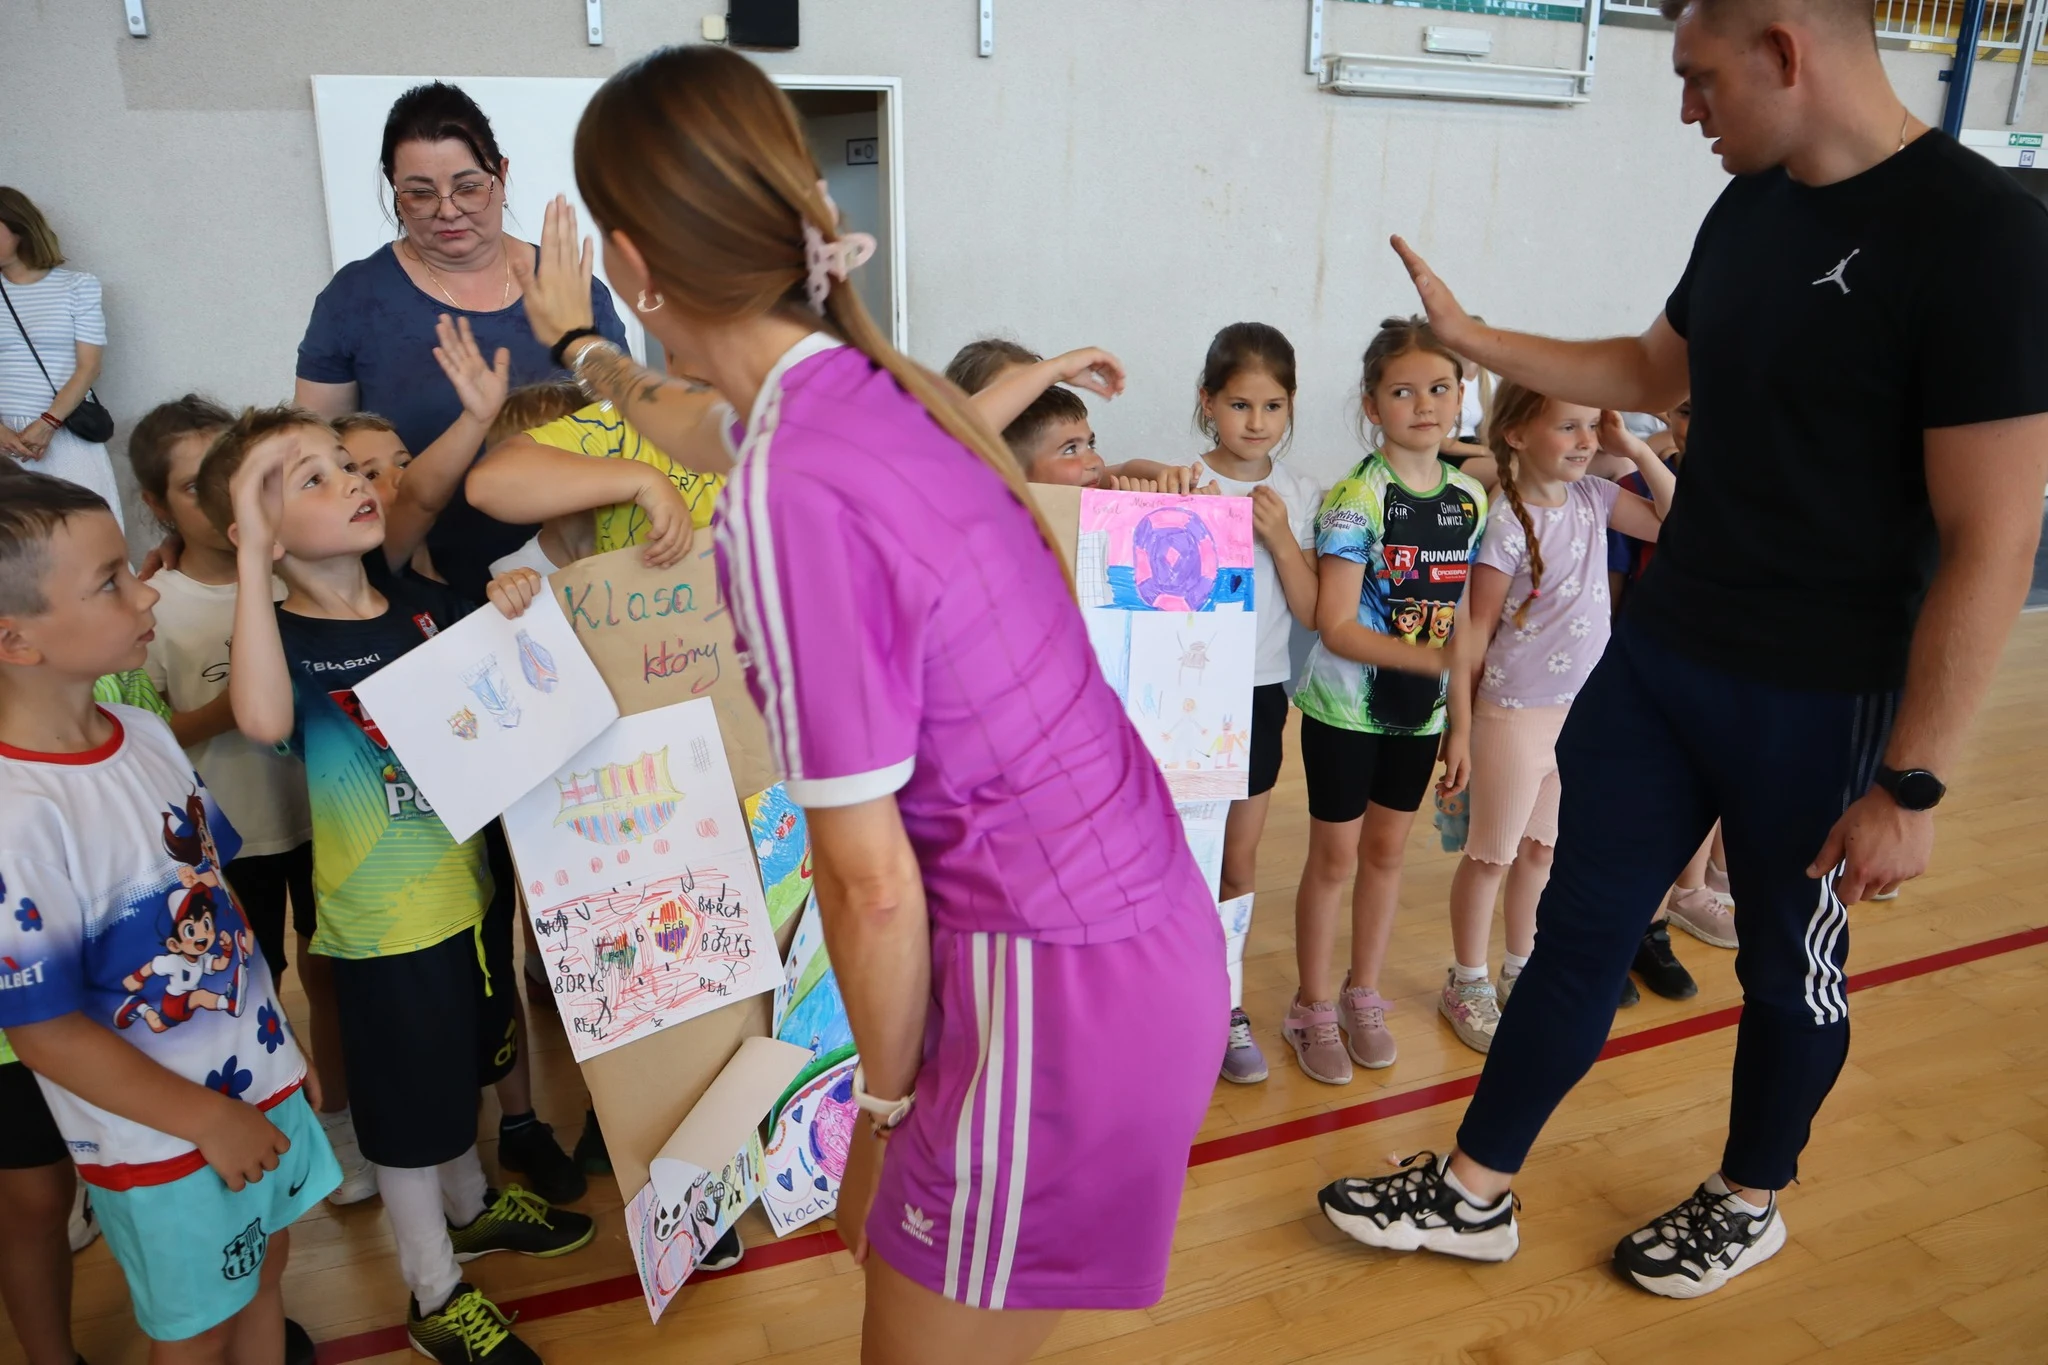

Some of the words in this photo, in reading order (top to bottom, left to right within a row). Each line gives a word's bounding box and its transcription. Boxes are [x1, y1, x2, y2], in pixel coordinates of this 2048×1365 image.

[668, 473, 699, 493] CR7
[1437, 514, 1463, 526] RAWICZ
[1376, 569, 1419, 579] JUNIOR
[564, 580, 698, 632] Klasa
[643, 638, 720, 694] który
[664, 920, 684, 933] FCB
[701, 932, 752, 958] BORYS
[554, 973, 605, 994] BORYS
[700, 977, 733, 996] REAL
[573, 1017, 608, 1040] REAL
